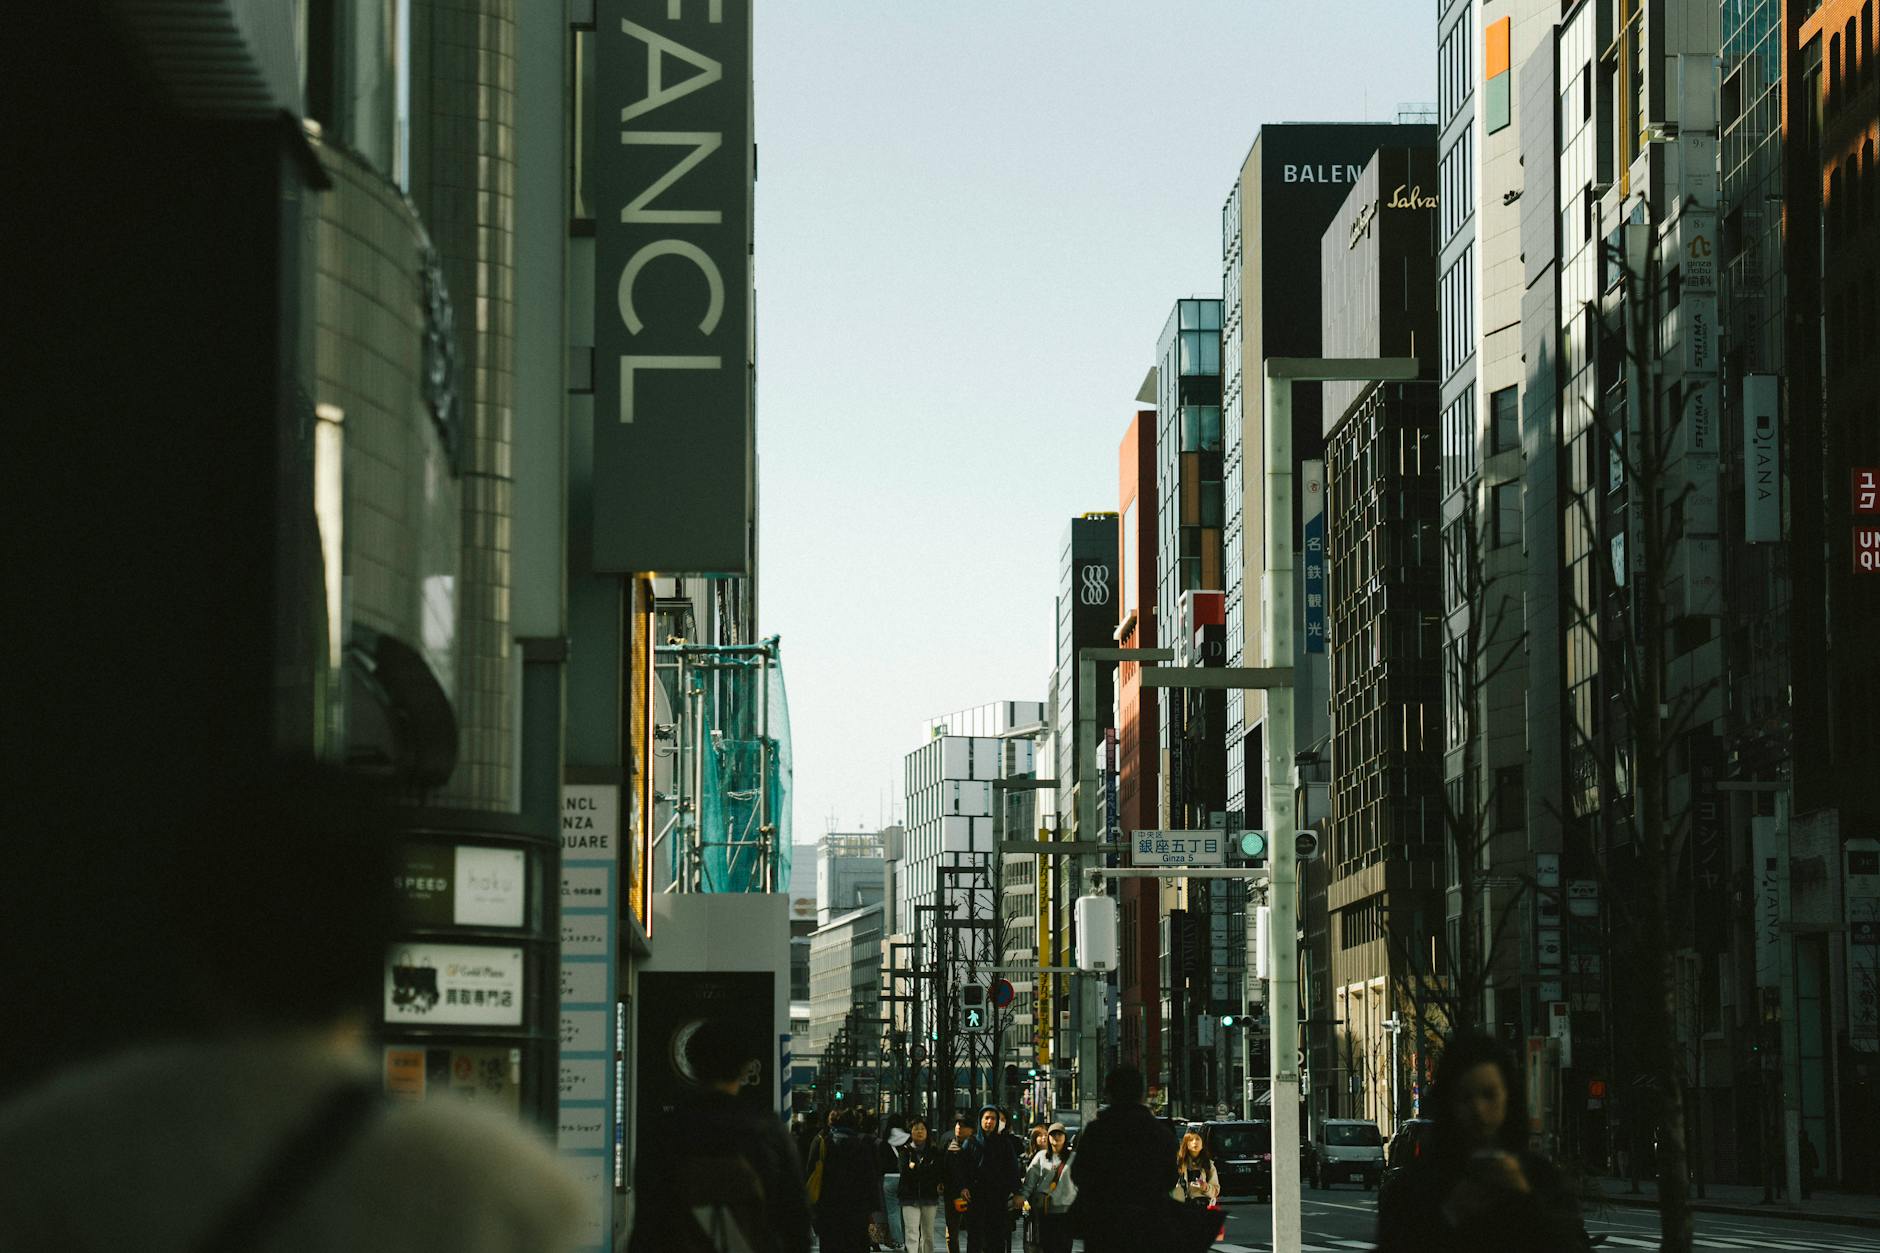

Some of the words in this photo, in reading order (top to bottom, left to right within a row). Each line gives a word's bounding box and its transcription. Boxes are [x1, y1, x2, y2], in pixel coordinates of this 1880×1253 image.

[1284, 164, 1362, 183] BALEN
[1387, 184, 1439, 209] Salva
[1687, 260, 1711, 268] ginza
[1694, 313, 1703, 368] SHIMA
[1695, 394, 1703, 448] SHIMA
[1755, 417, 1775, 501] DIANA
[1306, 537, 1323, 637] 名鉄観光
[560, 798, 597, 810] NCL
[563, 817, 594, 829] NZA
[1138, 831, 1163, 839] 中央区
[1138, 839, 1217, 854] 銀座五丁目
[1162, 854, 1186, 862] Ginza
[1188, 854, 1194, 862] 5
